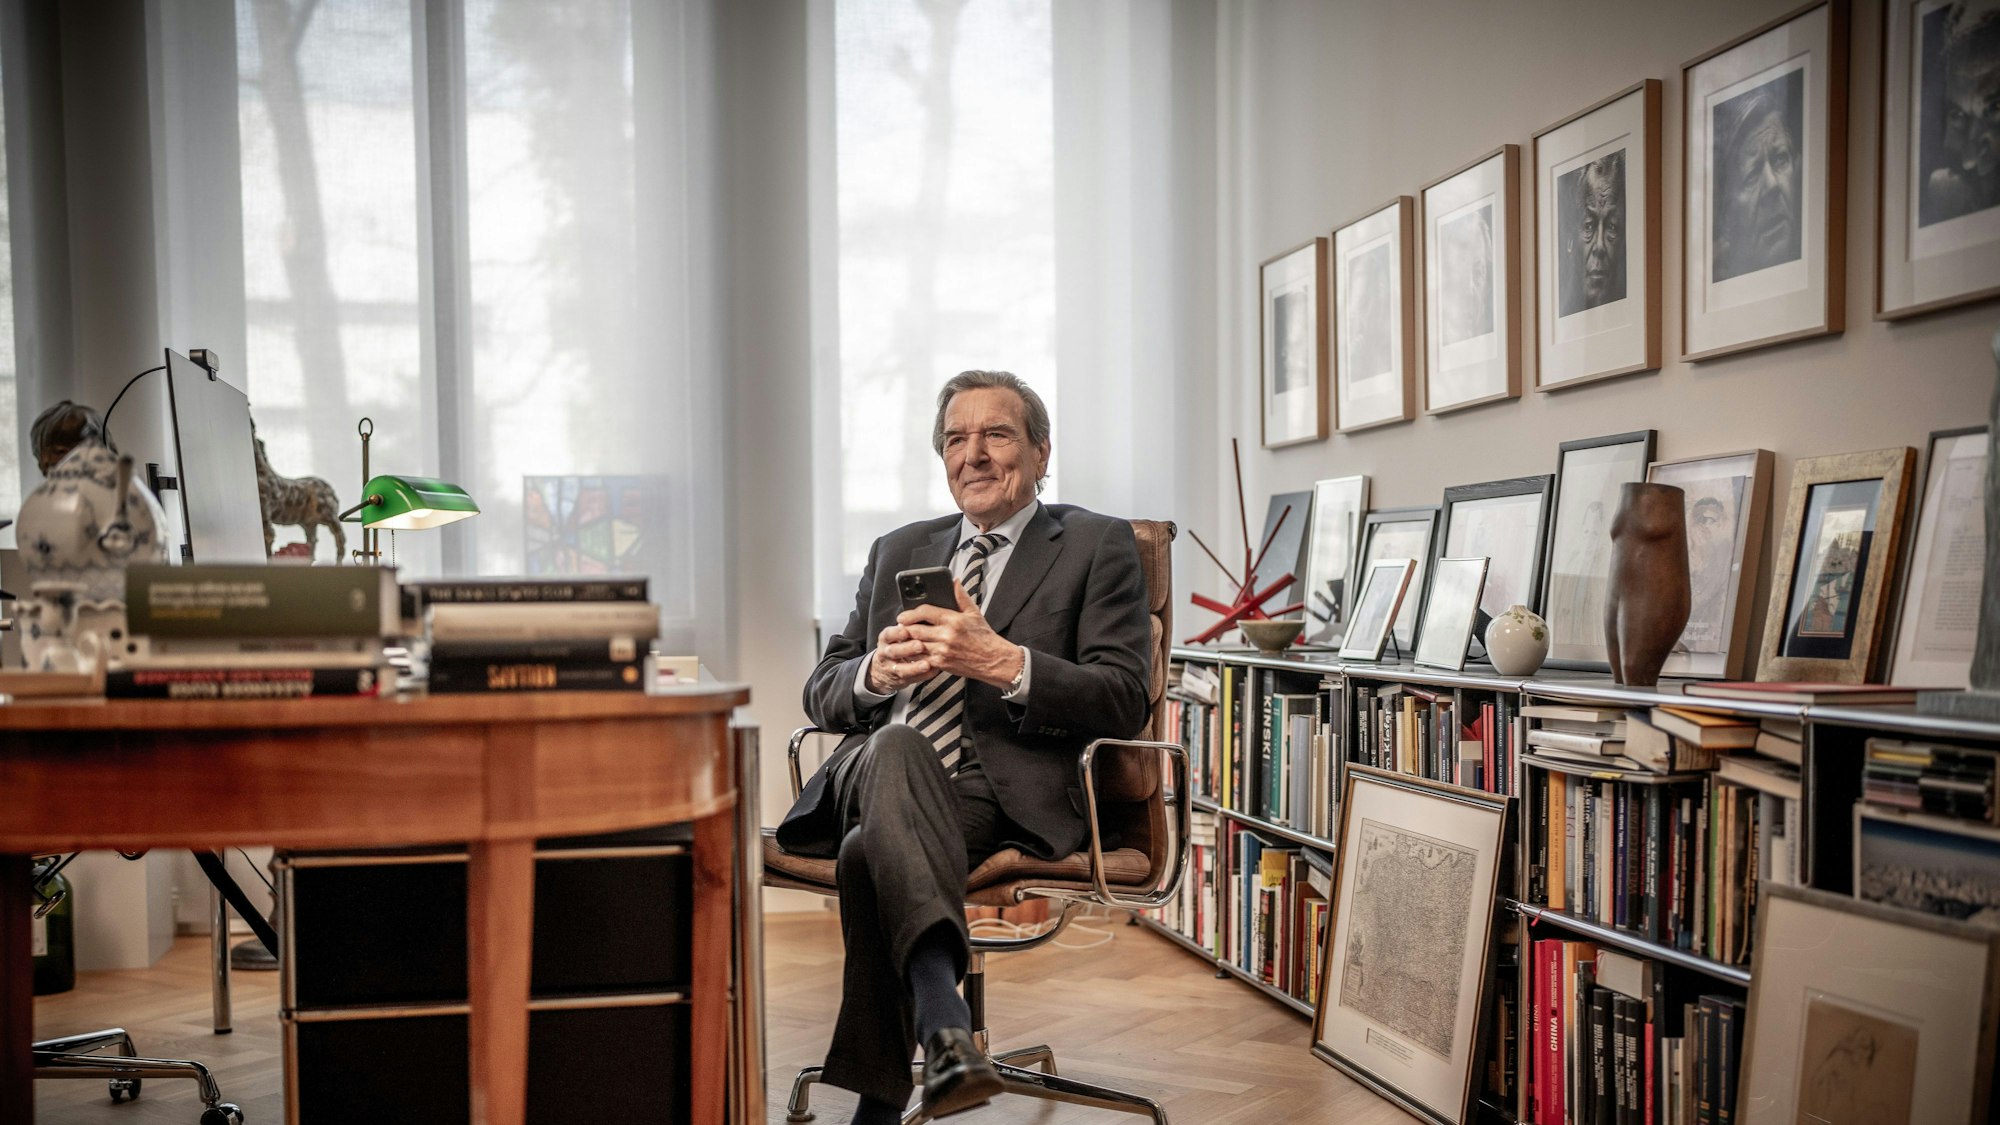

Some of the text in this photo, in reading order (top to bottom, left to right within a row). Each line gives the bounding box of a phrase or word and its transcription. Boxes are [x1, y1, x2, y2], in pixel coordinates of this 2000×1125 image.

[1262, 695, 1272, 760] KINSKI
[1565, 804, 1575, 839] 1913
[1550, 1017, 1558, 1051] CHINA
